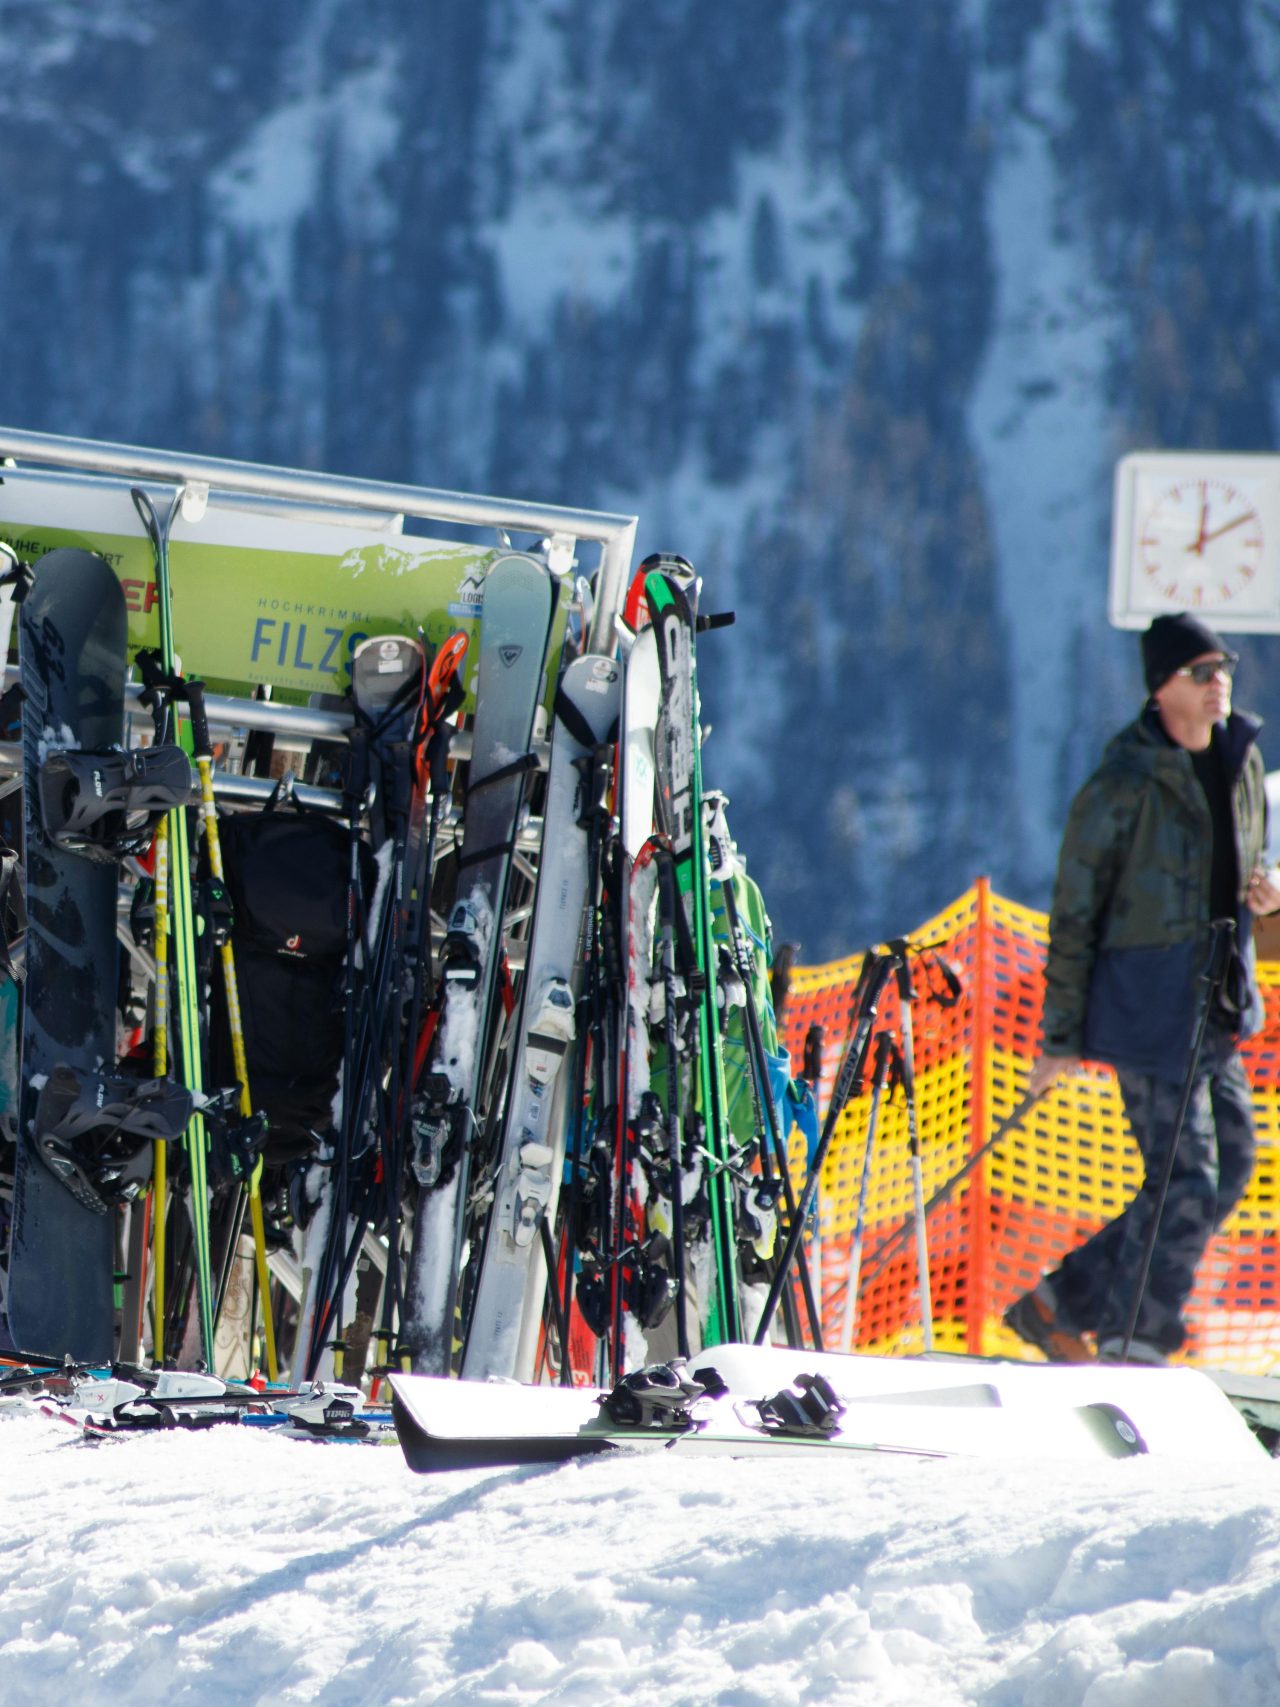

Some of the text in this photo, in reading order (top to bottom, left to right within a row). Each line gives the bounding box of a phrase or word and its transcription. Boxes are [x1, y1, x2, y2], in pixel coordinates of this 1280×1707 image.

[664, 612, 694, 855] HEAD
[93, 770, 103, 797] FLOW
[735, 926, 750, 971] LEKI
[96, 1083, 105, 1109] FLOW
